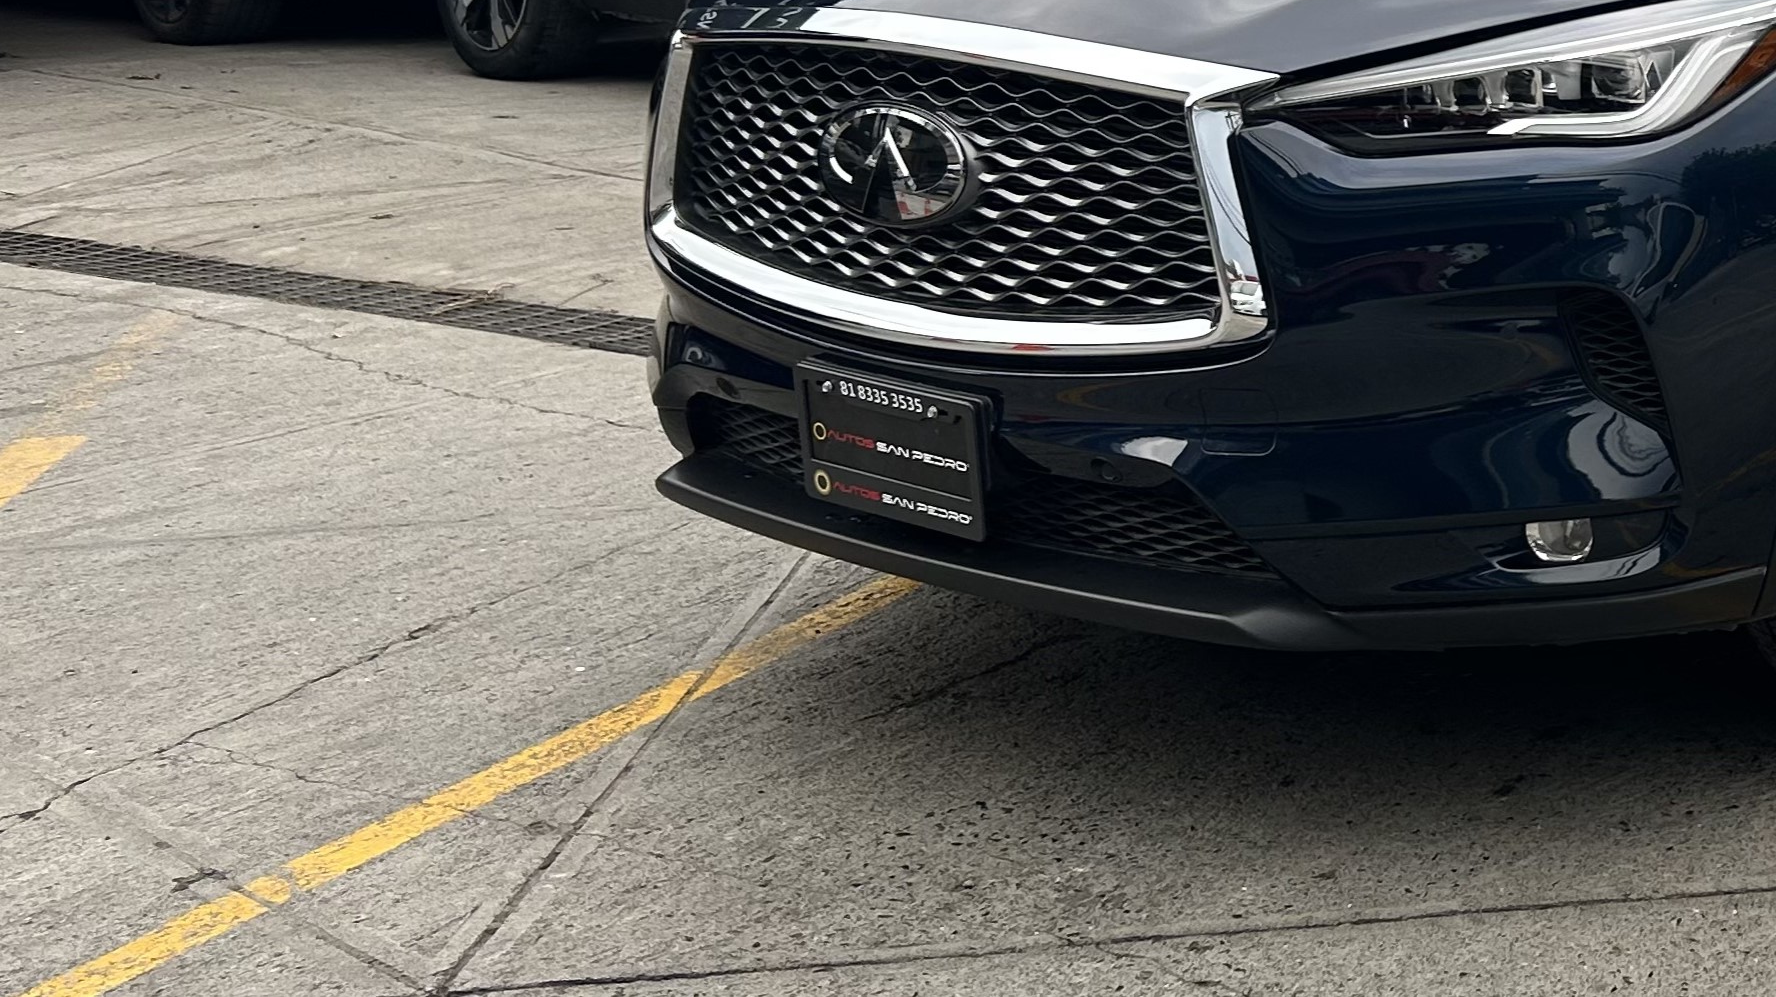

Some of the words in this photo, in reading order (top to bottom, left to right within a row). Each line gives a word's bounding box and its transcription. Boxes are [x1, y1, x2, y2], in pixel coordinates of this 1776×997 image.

[839, 380, 856, 398] 81
[857, 385, 889, 406] 8335
[890, 392, 923, 413] 3535
[827, 430, 875, 449] AUTOS
[876, 441, 910, 458] SAN
[911, 450, 968, 472] PEDRO
[832, 481, 881, 501] AUTOS
[882, 493, 915, 510] SAN
[915, 502, 971, 525] PEDRO
